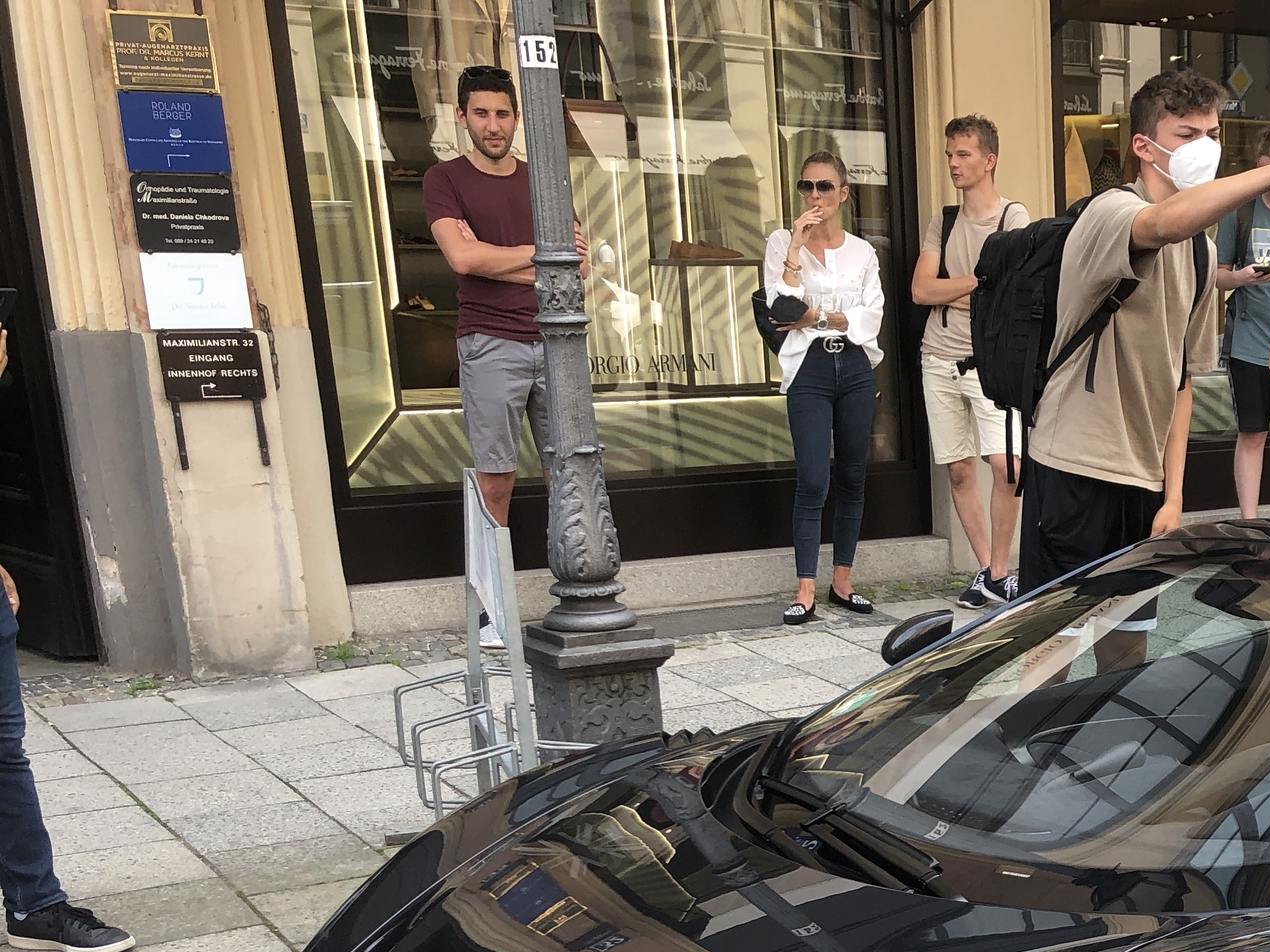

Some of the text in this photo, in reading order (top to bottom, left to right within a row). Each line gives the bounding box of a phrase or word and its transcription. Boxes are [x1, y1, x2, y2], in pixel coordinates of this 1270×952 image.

[523, 40, 557, 64] 152
[151, 101, 191, 112] ROLAND
[152, 111, 192, 121] BERGER
[162, 339, 254, 347] MAXIMILIANSTR. 32
[189, 354, 234, 362] EINGANG
[647, 353, 717, 373] ARMANI
[167, 369, 258, 378] INNENHOF RECHTS
